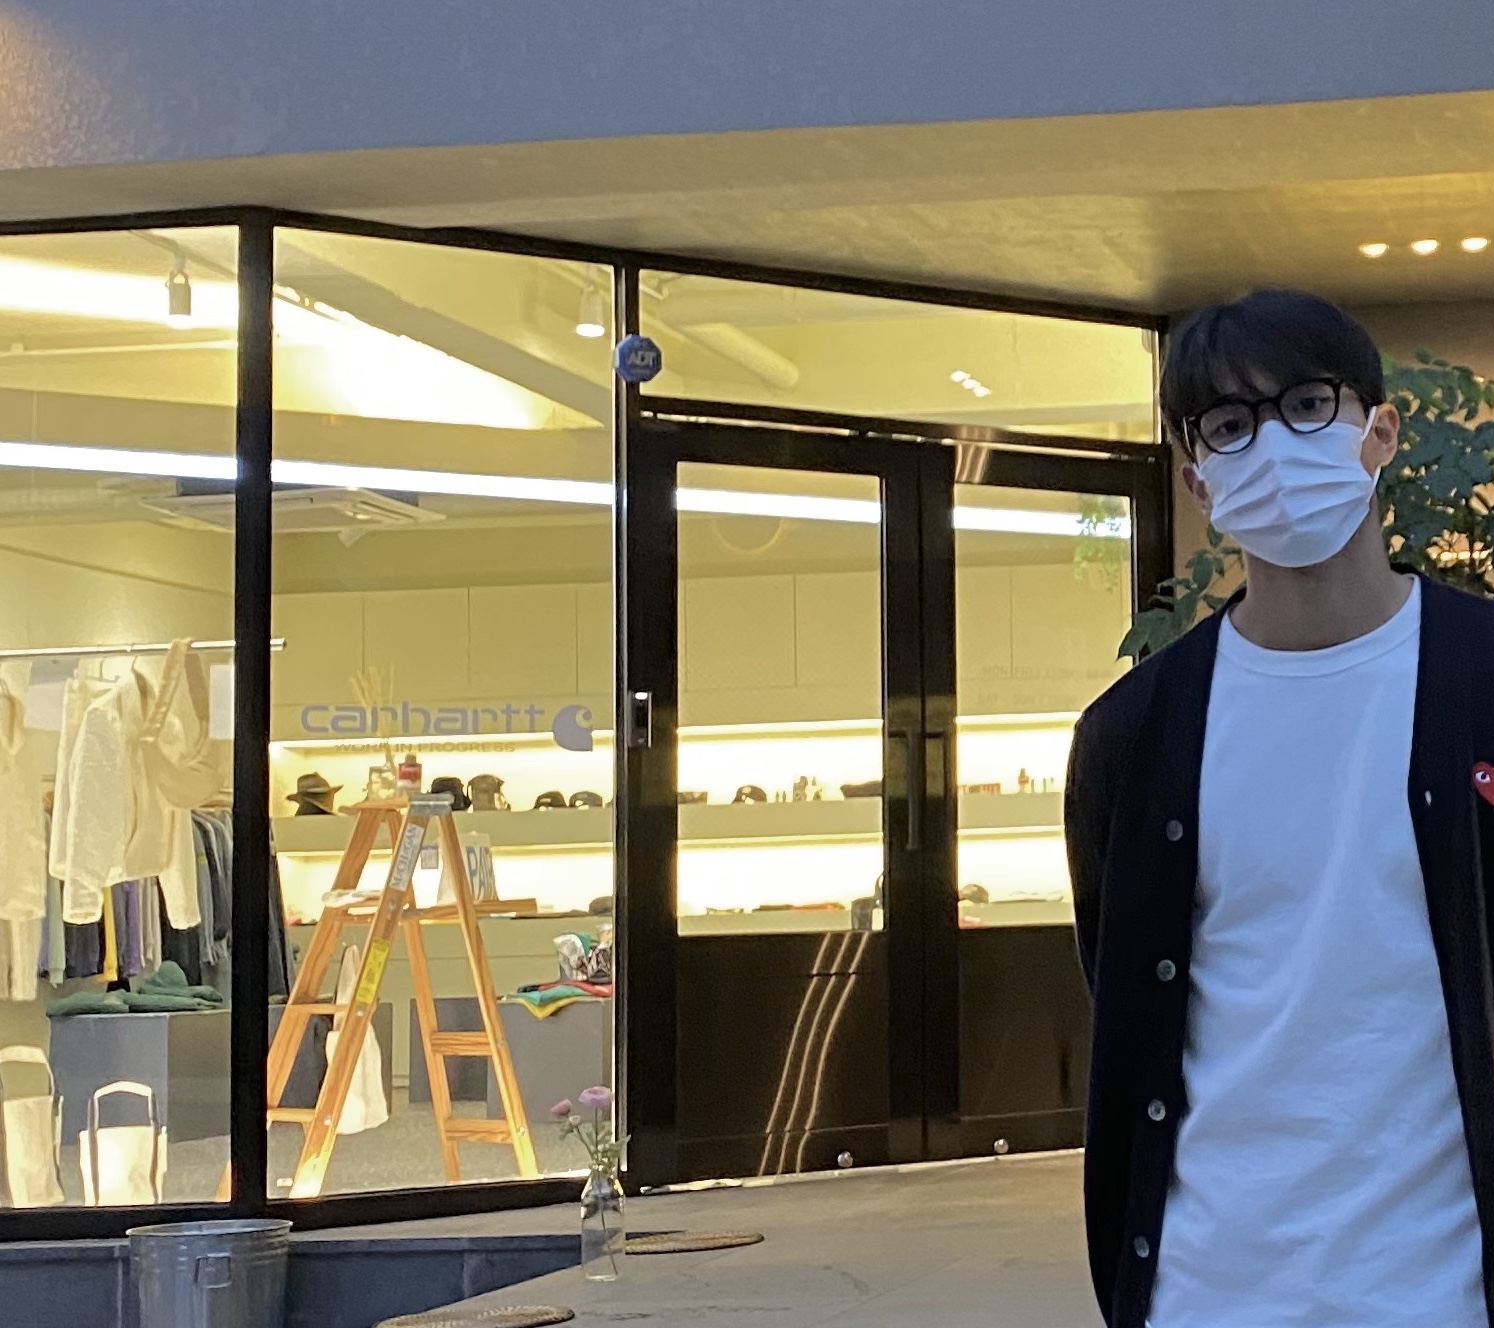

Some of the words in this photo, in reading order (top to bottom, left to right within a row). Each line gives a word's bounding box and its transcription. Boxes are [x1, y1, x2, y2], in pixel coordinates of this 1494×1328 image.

[627, 351, 657, 367] ADT
[301, 701, 545, 734] carhartt
[394, 742, 412, 753] IN
[418, 741, 516, 753] PROGRESS
